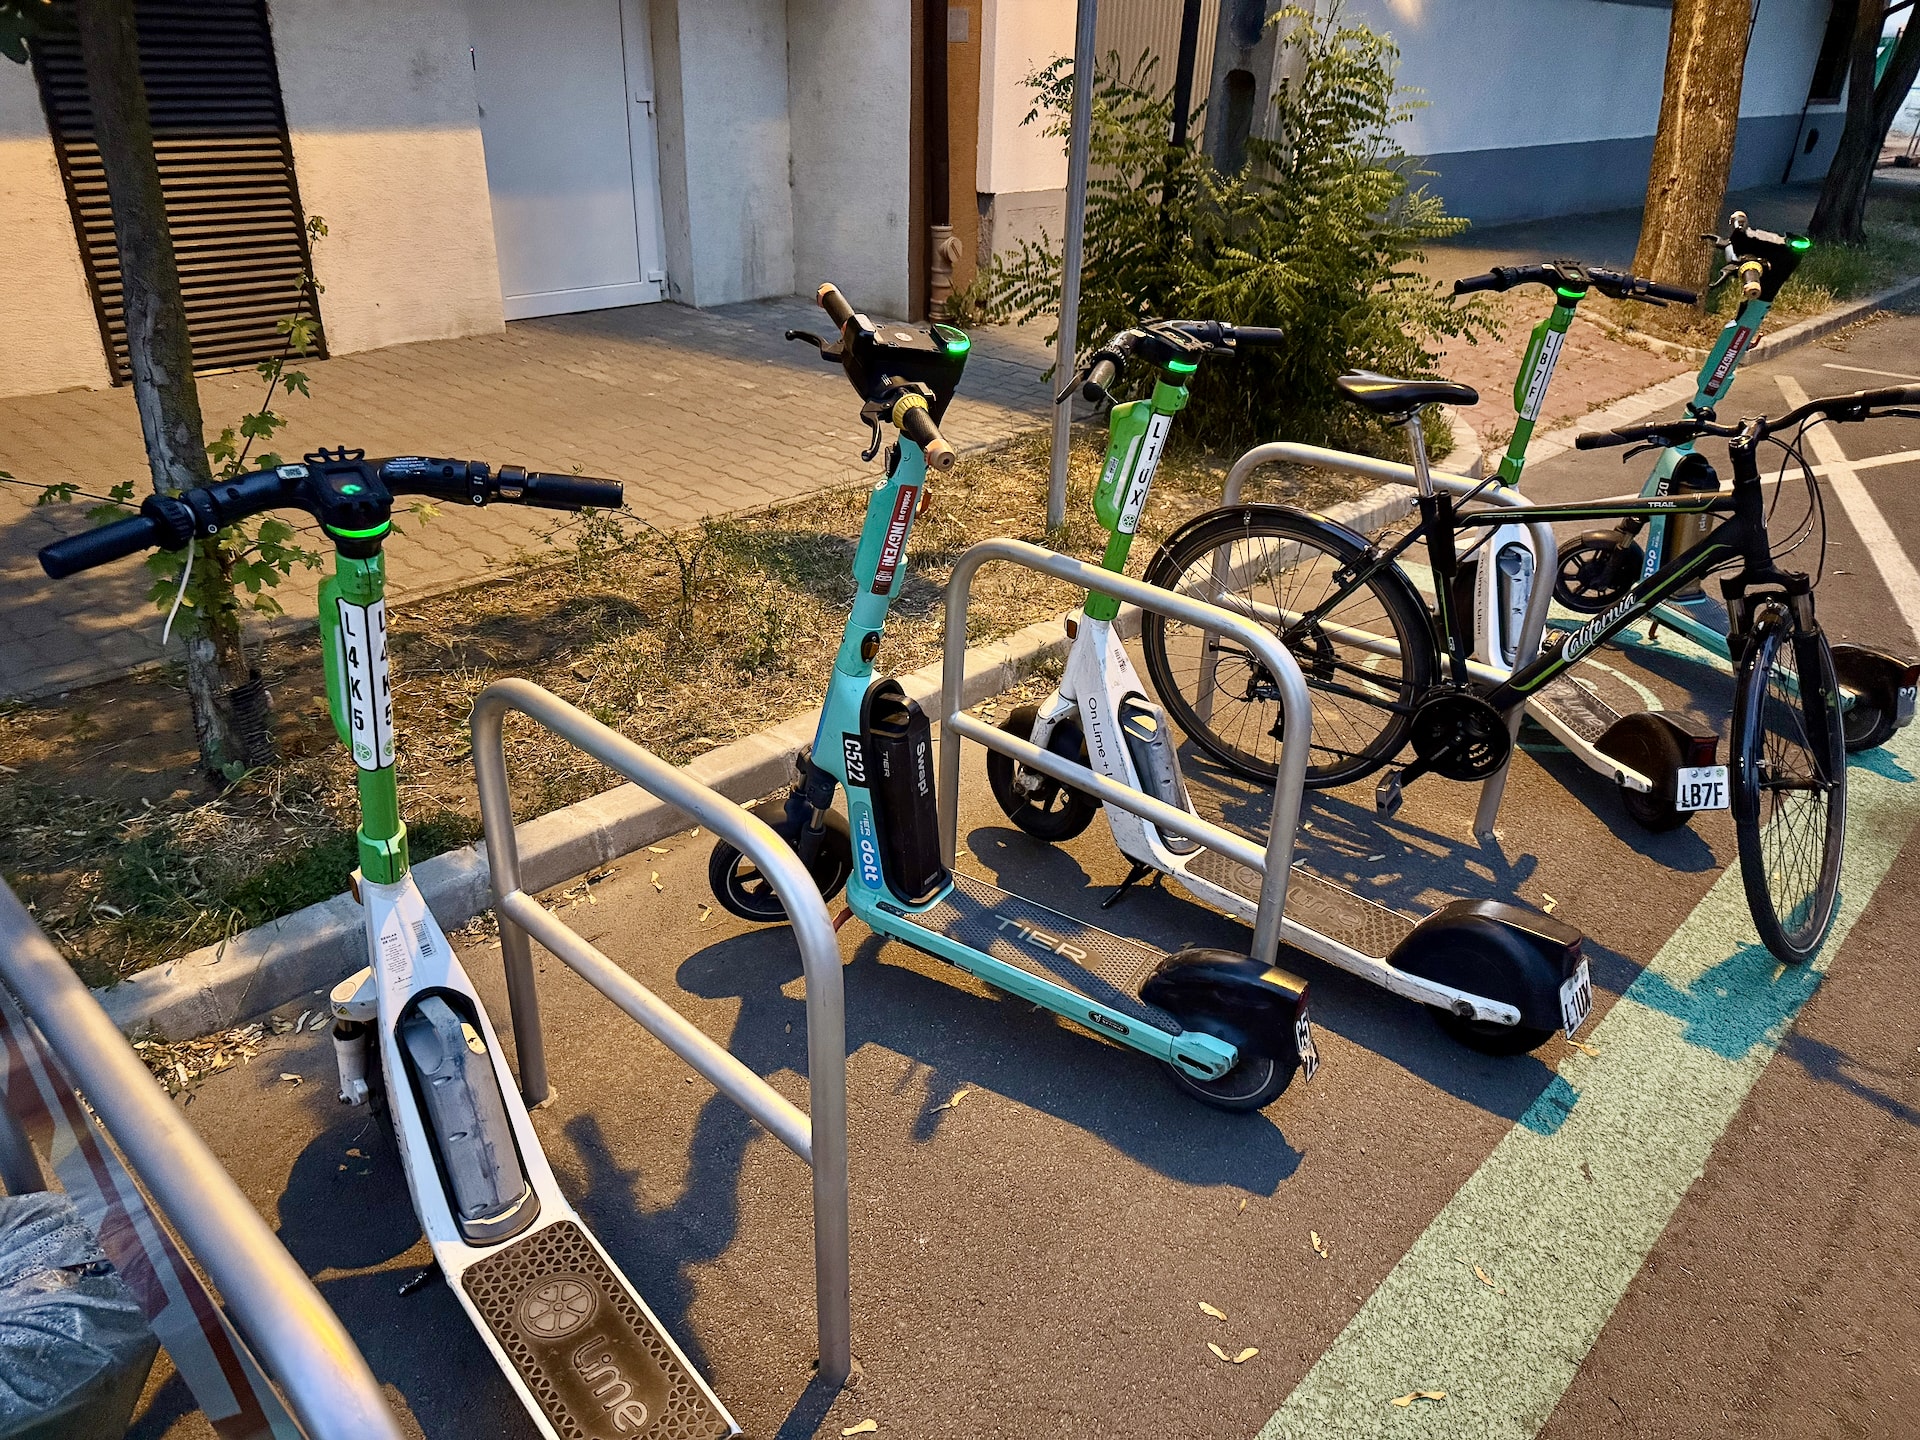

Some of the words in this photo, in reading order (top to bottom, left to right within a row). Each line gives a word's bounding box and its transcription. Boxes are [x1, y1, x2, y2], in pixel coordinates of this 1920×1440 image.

[1529, 335, 1552, 398] LB7F
[1130, 421, 1160, 506] L1UX
[881, 521, 907, 567] INGYEN!
[1562, 592, 1638, 662] California
[344, 611, 365, 731] L4K5
[1088, 697, 1099, 720] On
[844, 738, 866, 783] C522
[1092, 722, 1106, 759] Lime
[882, 751, 891, 778] TIER
[916, 741, 929, 797] Swap!
[1681, 782, 1724, 808] LB7F
[862, 810, 871, 836] TIER
[860, 838, 879, 882] dott
[995, 914, 1088, 966] TIER
